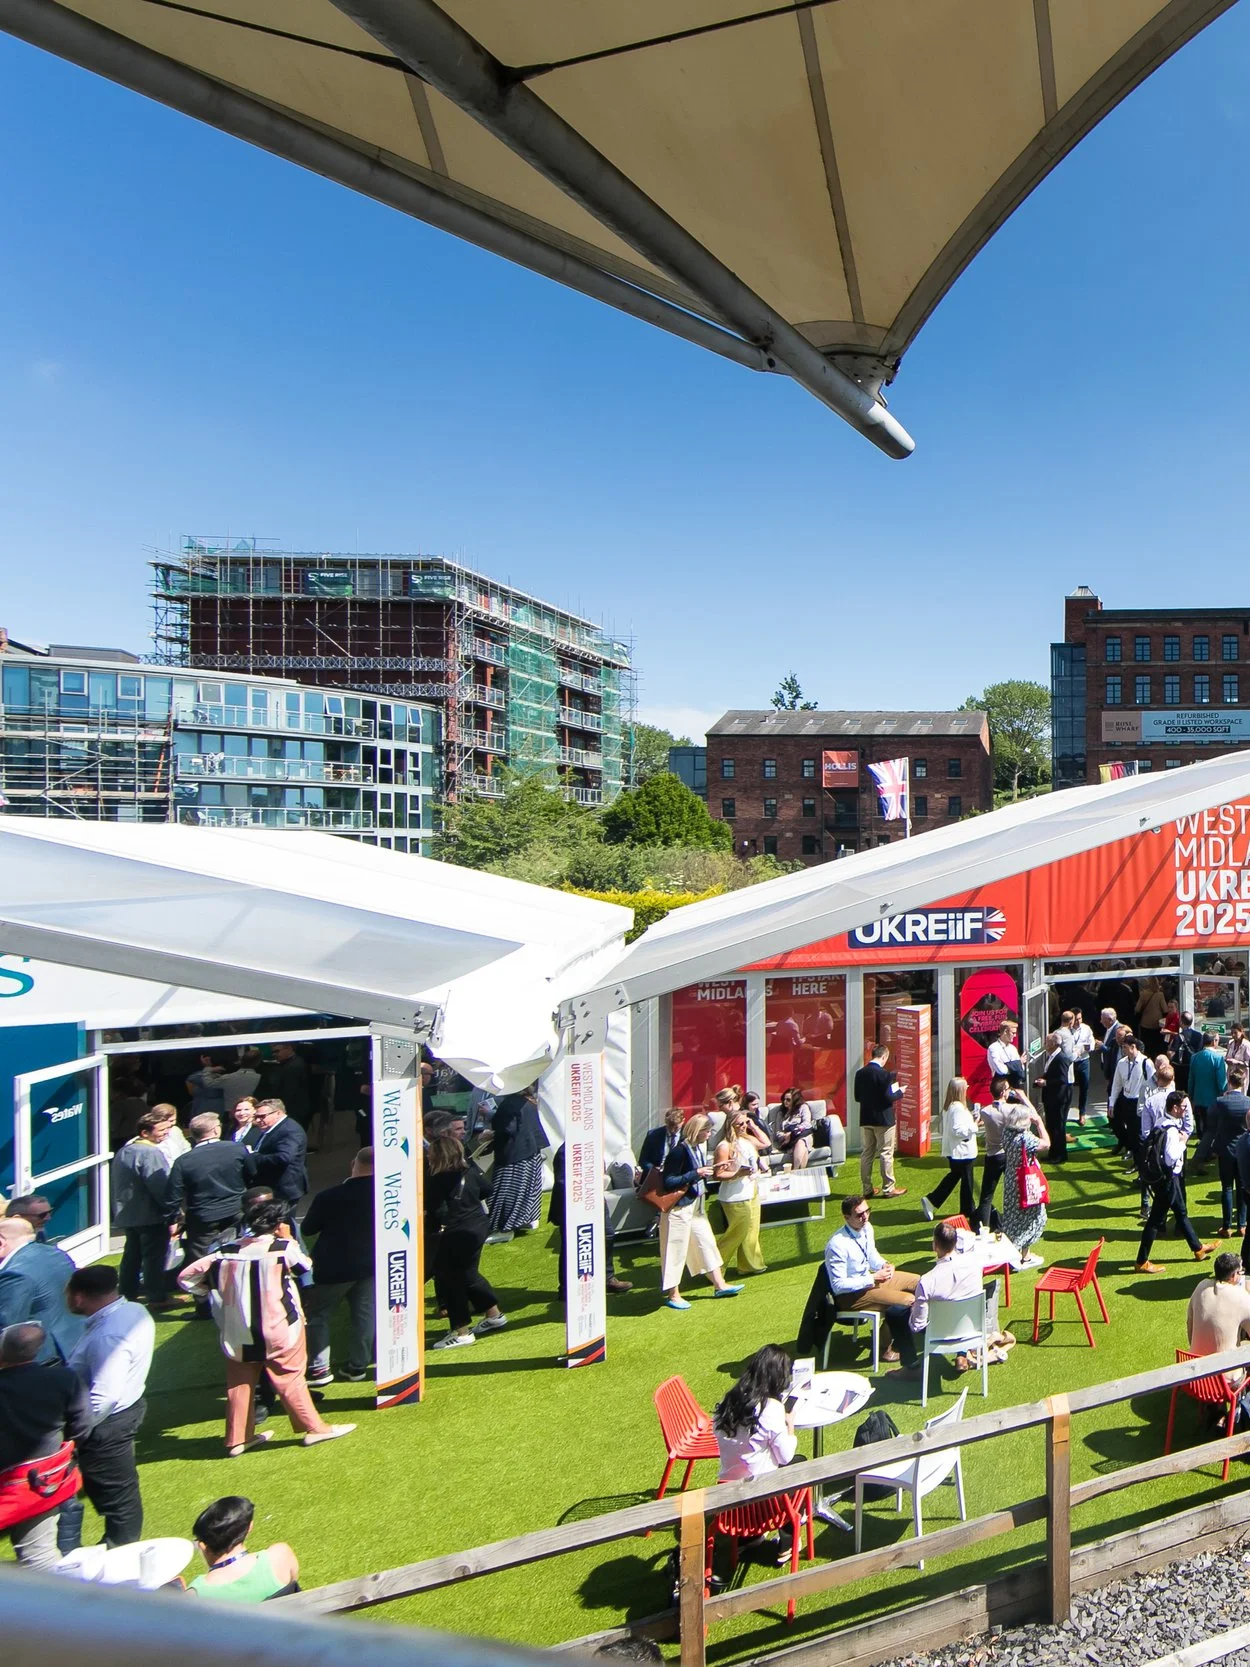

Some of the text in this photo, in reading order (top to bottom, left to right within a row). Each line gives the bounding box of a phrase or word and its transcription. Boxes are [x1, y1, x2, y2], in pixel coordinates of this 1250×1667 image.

[824, 762, 857, 770] HOLLIS
[1175, 805, 1250, 835] WEST
[855, 912, 983, 944] UKREiiF
[792, 982, 827, 996] HERE
[571, 1099, 582, 1122] 2025
[582, 1061, 594, 1131] WEST MIDLANDS
[383, 1089, 401, 1148] Wates
[572, 1179, 583, 1203] 2025
[583, 1140, 595, 1211] WEST MIDLANDS
[383, 1171, 402, 1230] Wates
[578, 1225, 592, 1274] UKREiiF
[390, 1252, 405, 1304] UKREiiF
